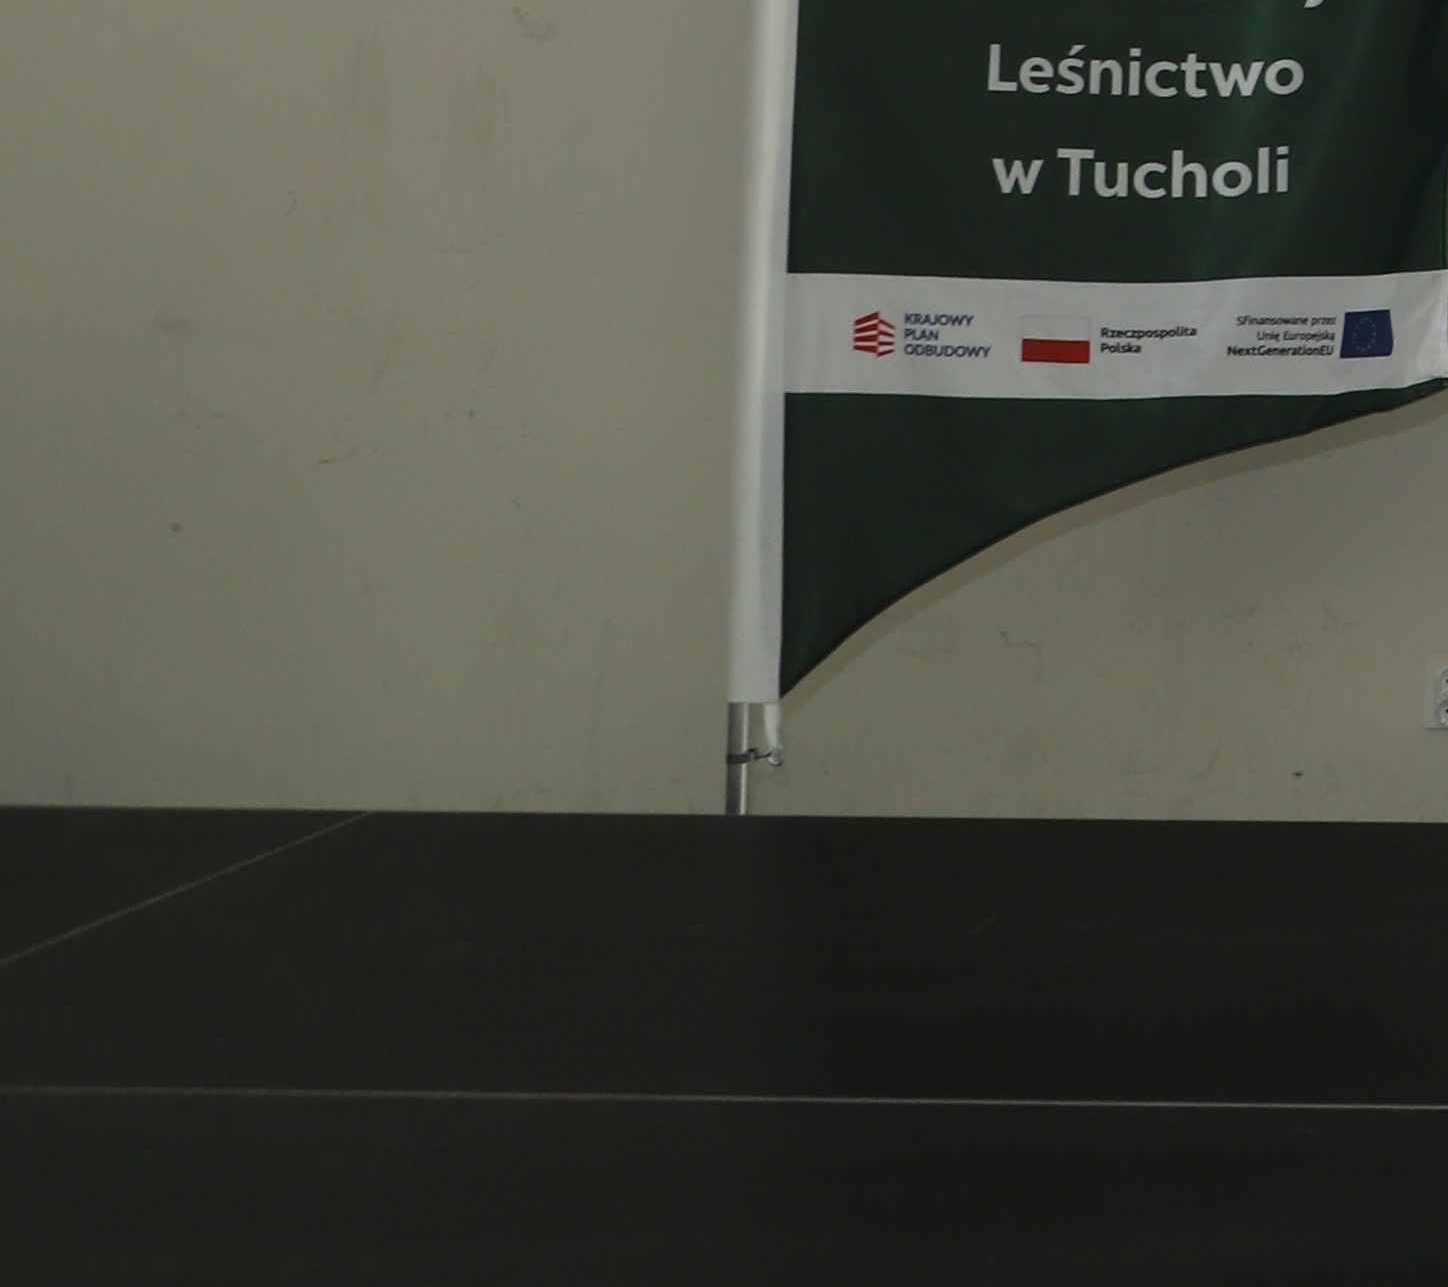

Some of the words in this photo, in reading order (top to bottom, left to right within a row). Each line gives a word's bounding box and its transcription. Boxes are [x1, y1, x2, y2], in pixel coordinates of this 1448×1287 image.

[987, 43, 1305, 98] Leśnictwo
[991, 159, 1044, 195] w
[1057, 145, 1291, 199] Tucholi
[904, 313, 975, 327] KRAJOWY
[1236, 315, 1308, 326] Sfinansowane
[904, 328, 939, 341] PLAN
[1100, 326, 1197, 340] Rzeczpospolita
[1257, 331, 1280, 342] Unię
[1284, 330, 1335, 342] Europejską
[904, 344, 992, 358] ODBUDOWY
[1100, 343, 1141, 353] Polska
[1227, 345, 1334, 356] NextGenerationEU
